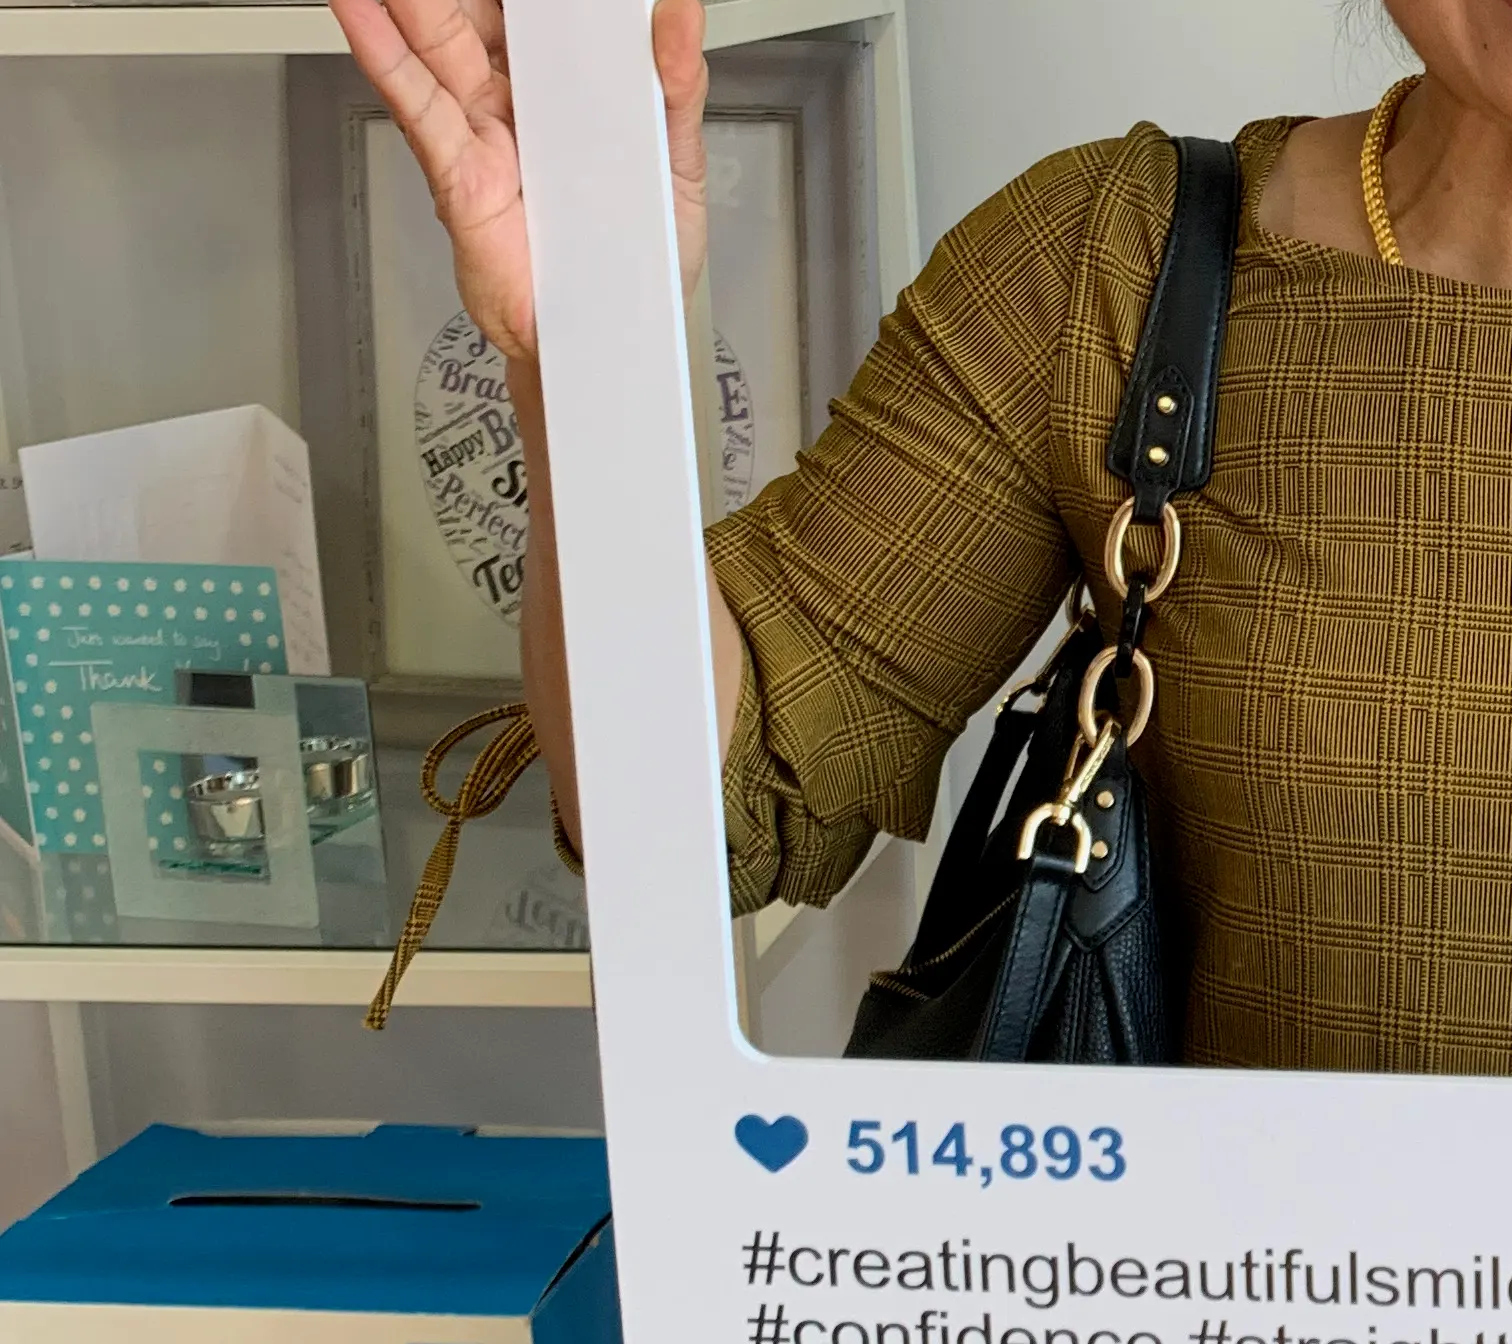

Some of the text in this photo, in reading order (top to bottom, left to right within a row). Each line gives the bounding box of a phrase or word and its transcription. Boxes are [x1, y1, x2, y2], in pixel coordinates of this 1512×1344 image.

[420, 429, 485, 478] Happy
[436, 473, 527, 550] Perfect
[173, 629, 187, 646] to
[49, 660, 162, 692] Thank
[846, 1118, 1127, 1189] 514,893
